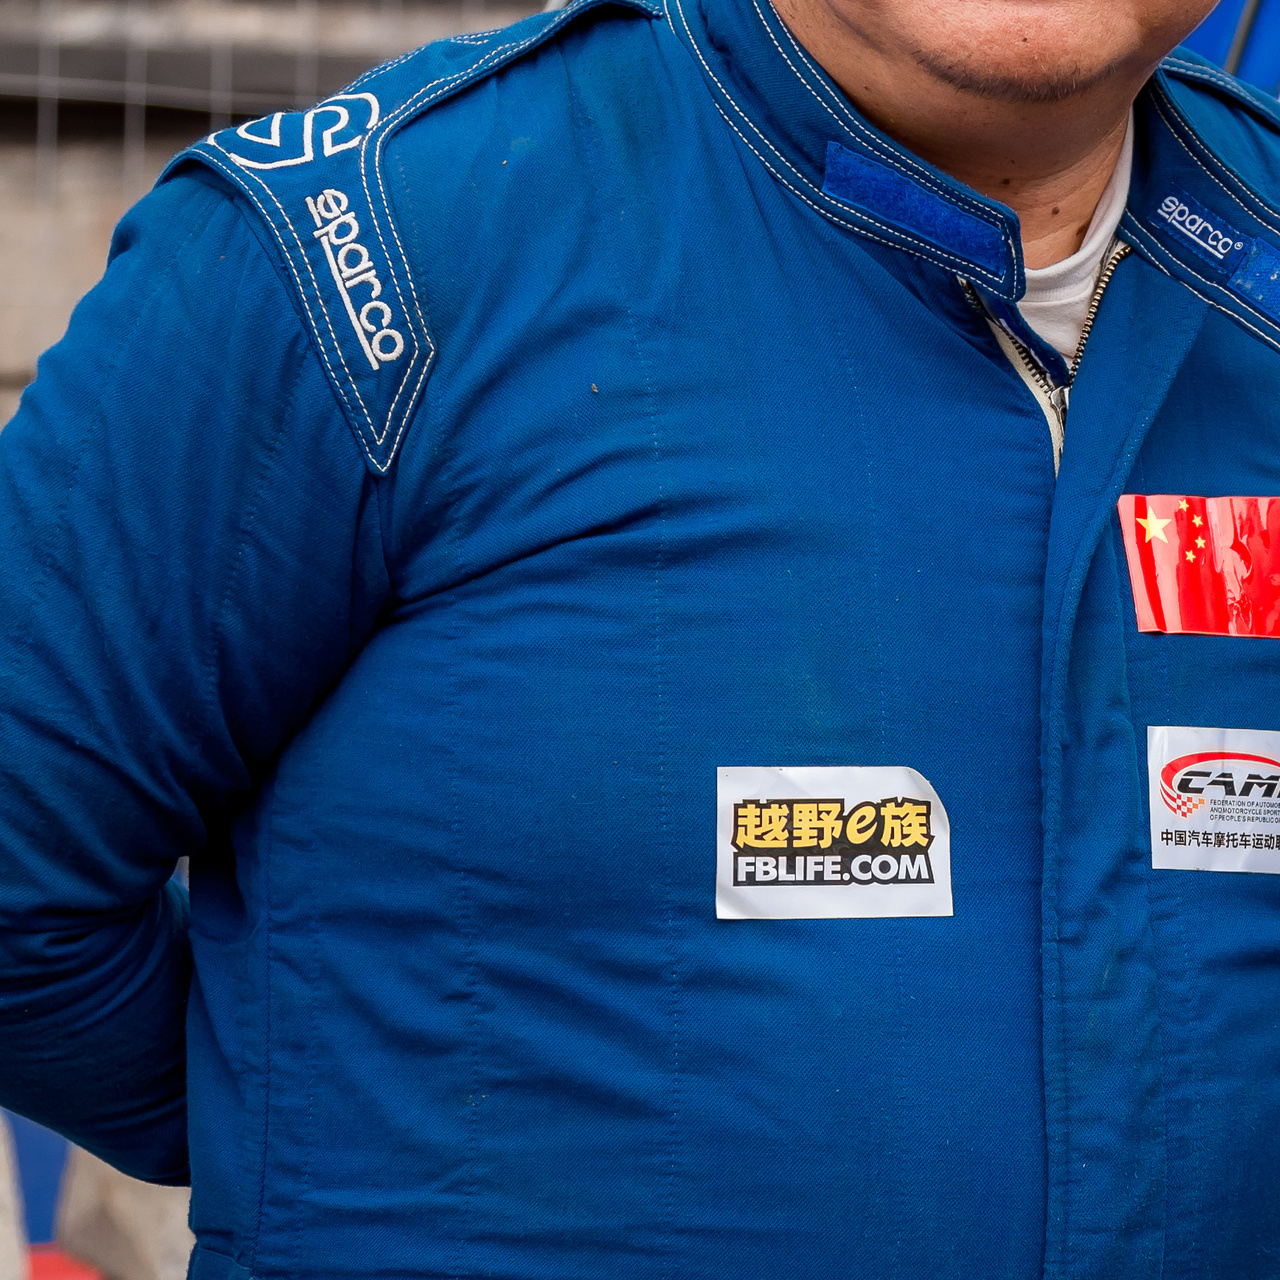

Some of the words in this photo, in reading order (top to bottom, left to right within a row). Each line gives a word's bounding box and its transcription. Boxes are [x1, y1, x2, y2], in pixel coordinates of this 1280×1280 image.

[305, 188, 404, 371] sparco
[1210, 798, 1246, 807] FEDERATION
[735, 799, 931, 849] 越野e族
[1247, 815, 1274, 825] REPUBLIC
[736, 853, 930, 882] FBLIFE.COM
